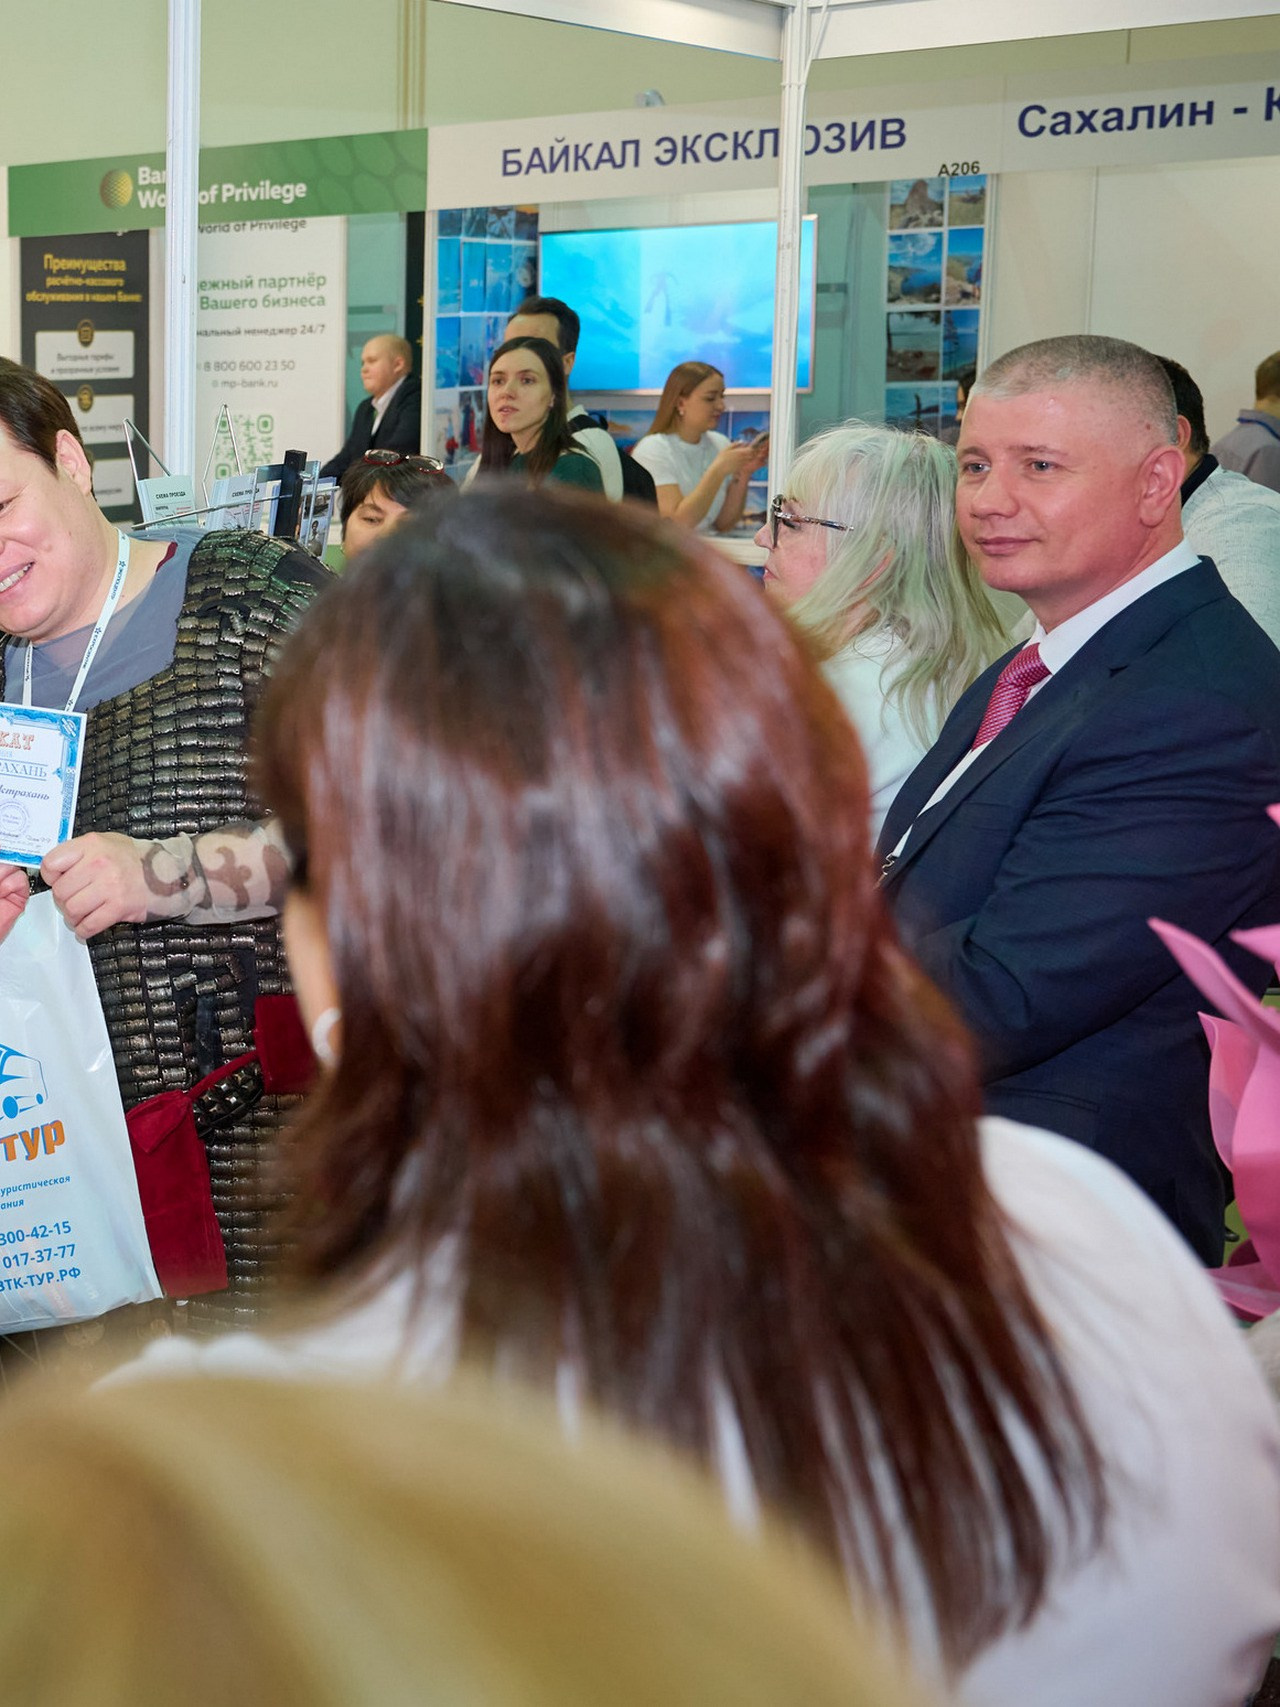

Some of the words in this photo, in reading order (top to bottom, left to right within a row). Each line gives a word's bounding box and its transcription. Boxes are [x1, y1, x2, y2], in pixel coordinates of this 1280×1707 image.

[1018, 100, 1214, 138] Сахалин
[501, 137, 641, 177] БАЙКАЛ
[199, 184, 219, 204] of
[222, 179, 306, 204] Privilege
[43, 253, 127, 274] Преимущества
[198, 276, 254, 293] ежный
[258, 272, 326, 291] партнёр
[200, 296, 258, 310] Вашего
[262, 293, 326, 308] бизнеса
[244, 326, 298, 338] менеджер
[300, 324, 326, 335] 24/7
[214, 361, 236, 372] 800
[264, 360, 278, 371] 23
[281, 360, 295, 371] 50
[221, 378, 278, 389] mp-bank.ru
[3, 1243, 77, 1269] 017-37-77
